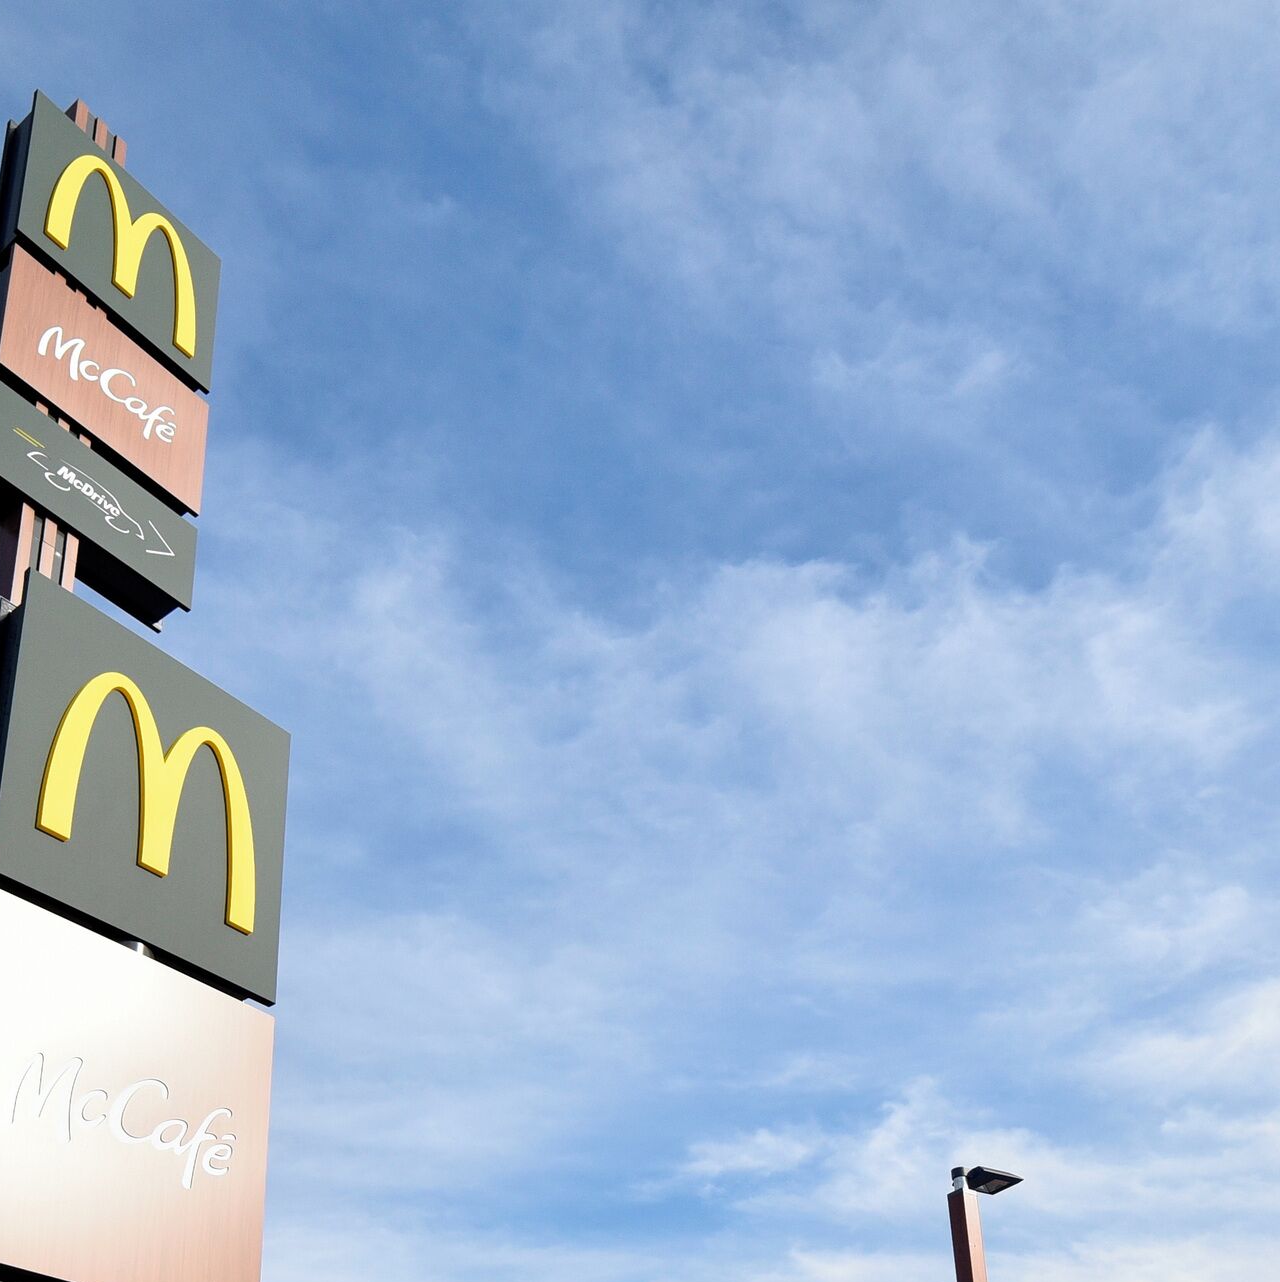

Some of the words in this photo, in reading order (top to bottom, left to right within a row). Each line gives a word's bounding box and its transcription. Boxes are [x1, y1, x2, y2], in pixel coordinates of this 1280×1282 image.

[37, 325, 177, 444] McCafé
[56, 465, 121, 518] McDrive
[13, 1052, 236, 1189] McCafé
